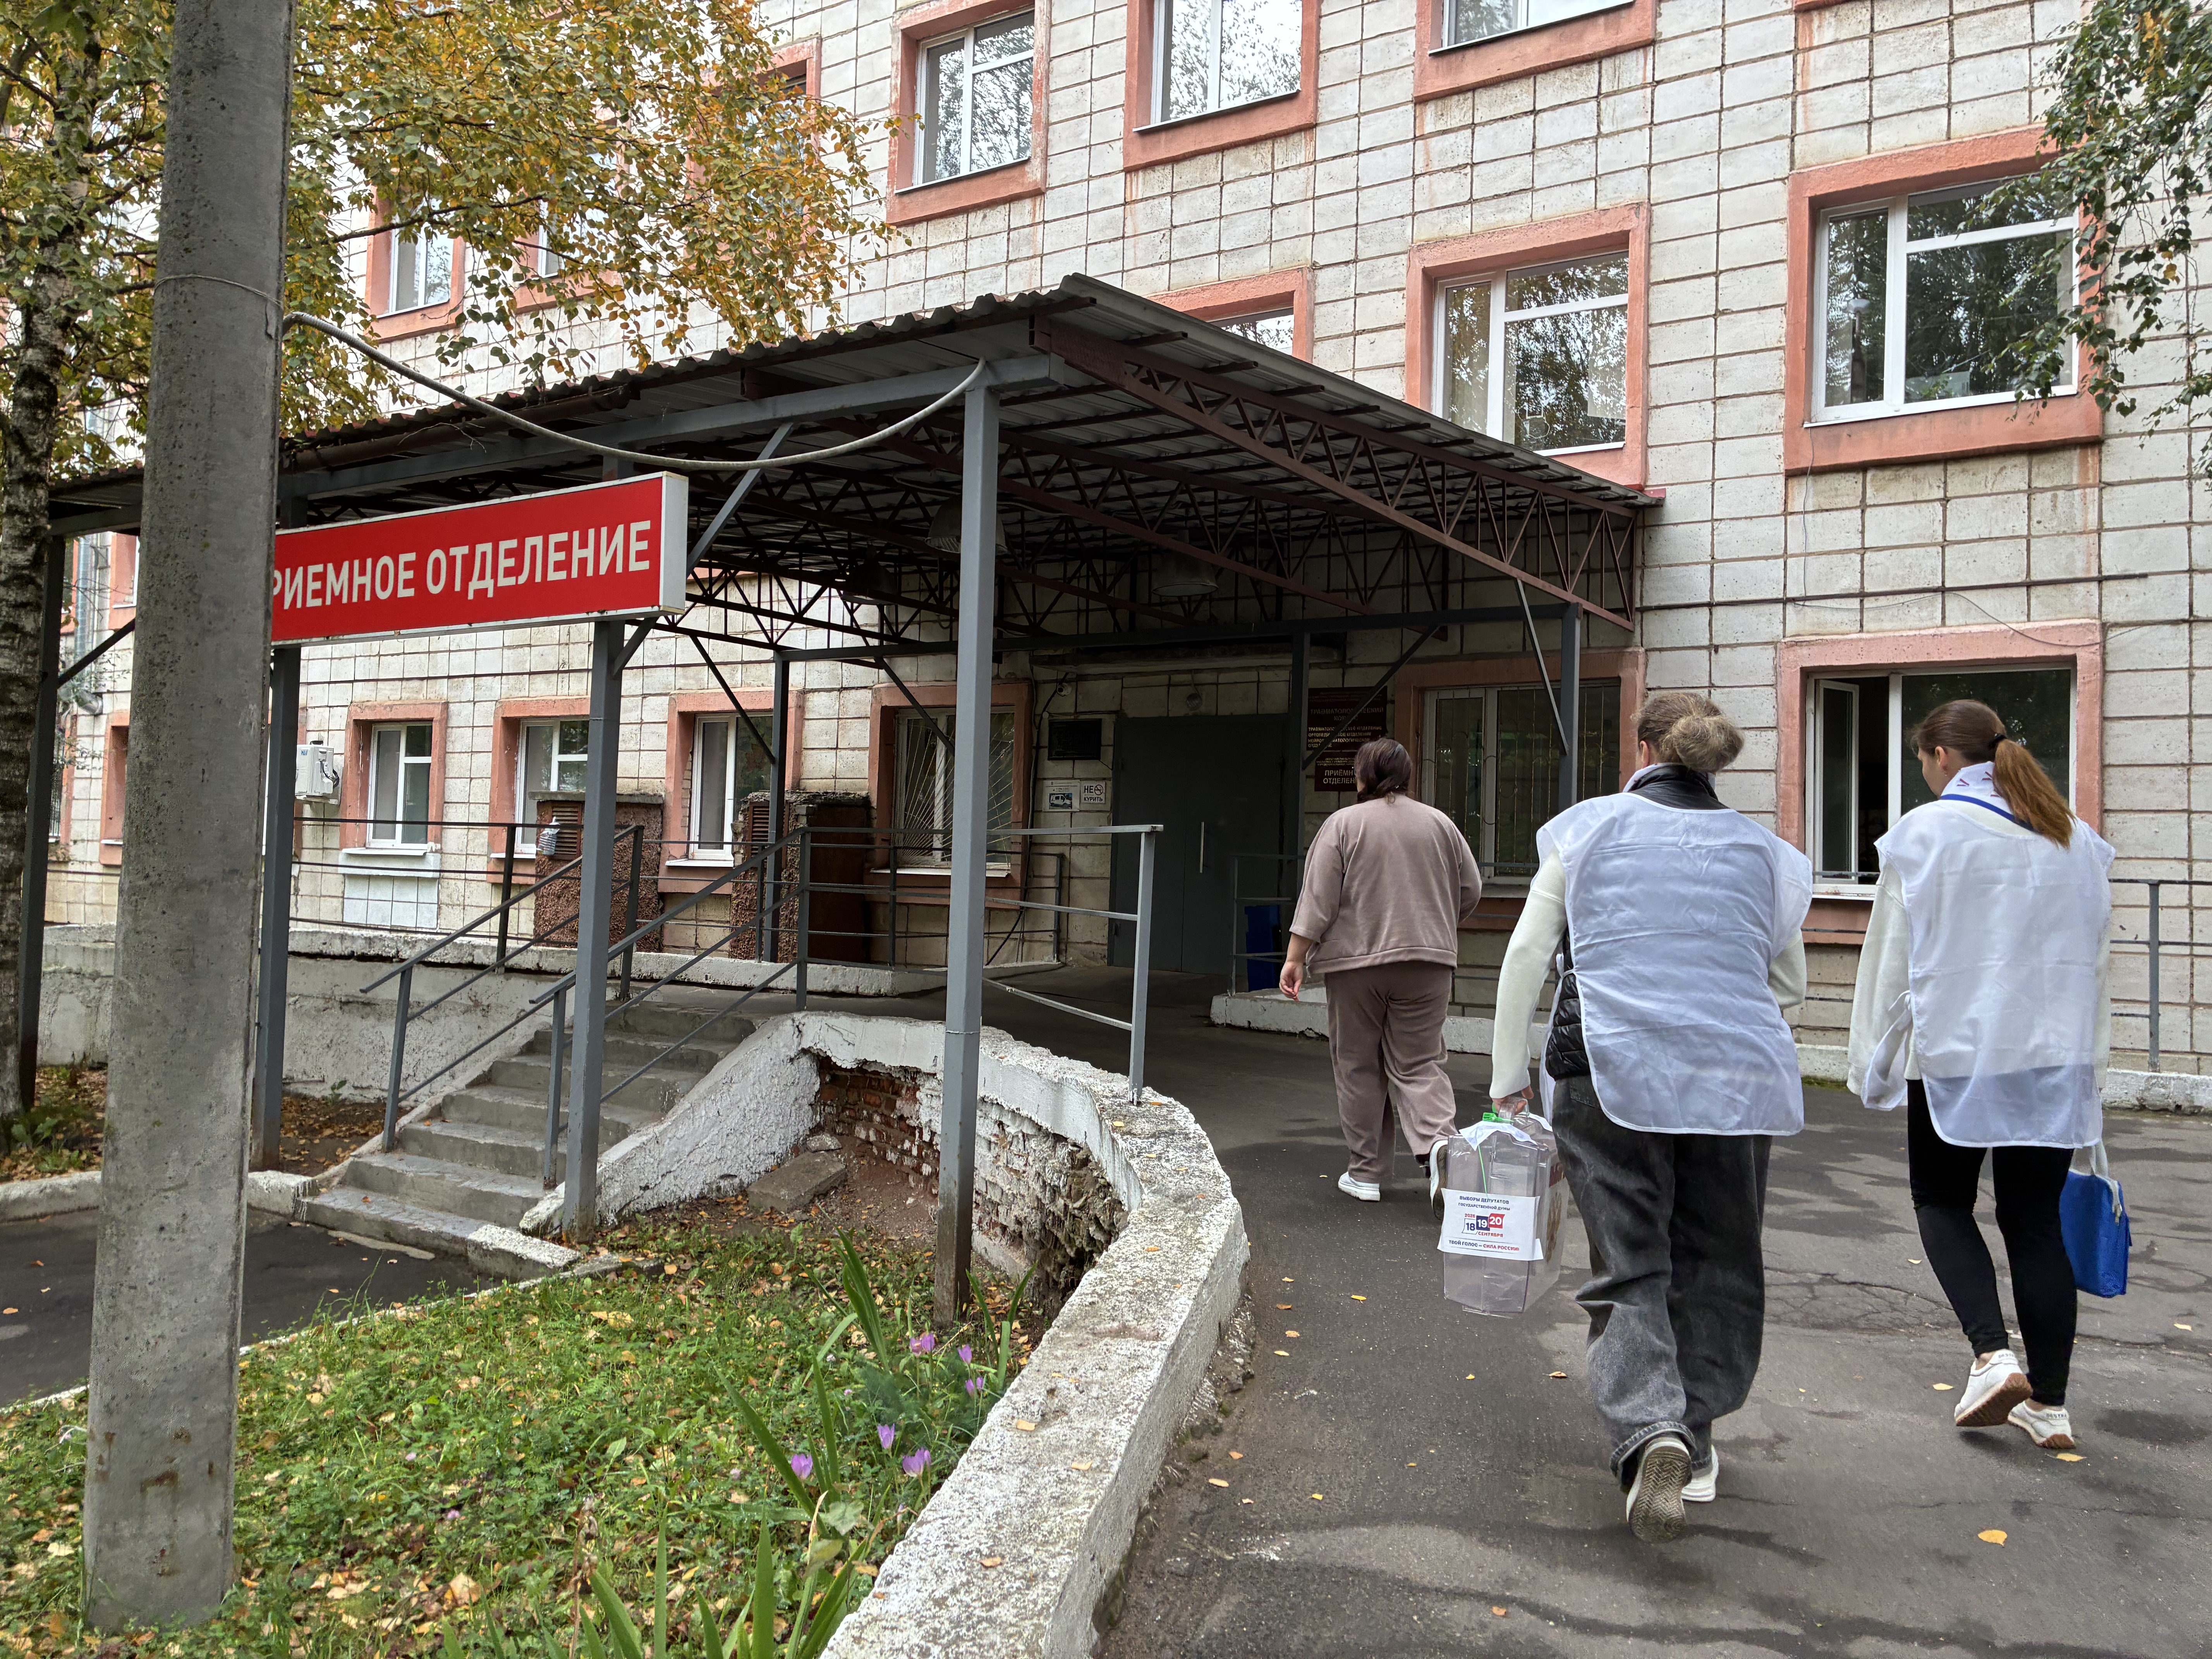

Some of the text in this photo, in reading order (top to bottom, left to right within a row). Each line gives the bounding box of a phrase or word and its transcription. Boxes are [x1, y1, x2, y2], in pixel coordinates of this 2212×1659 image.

[273, 520, 651, 610] РИЕМНОЕ ОТДЕЛЕНИЕ
[1465, 1216, 1502, 1231] 18 19 20
